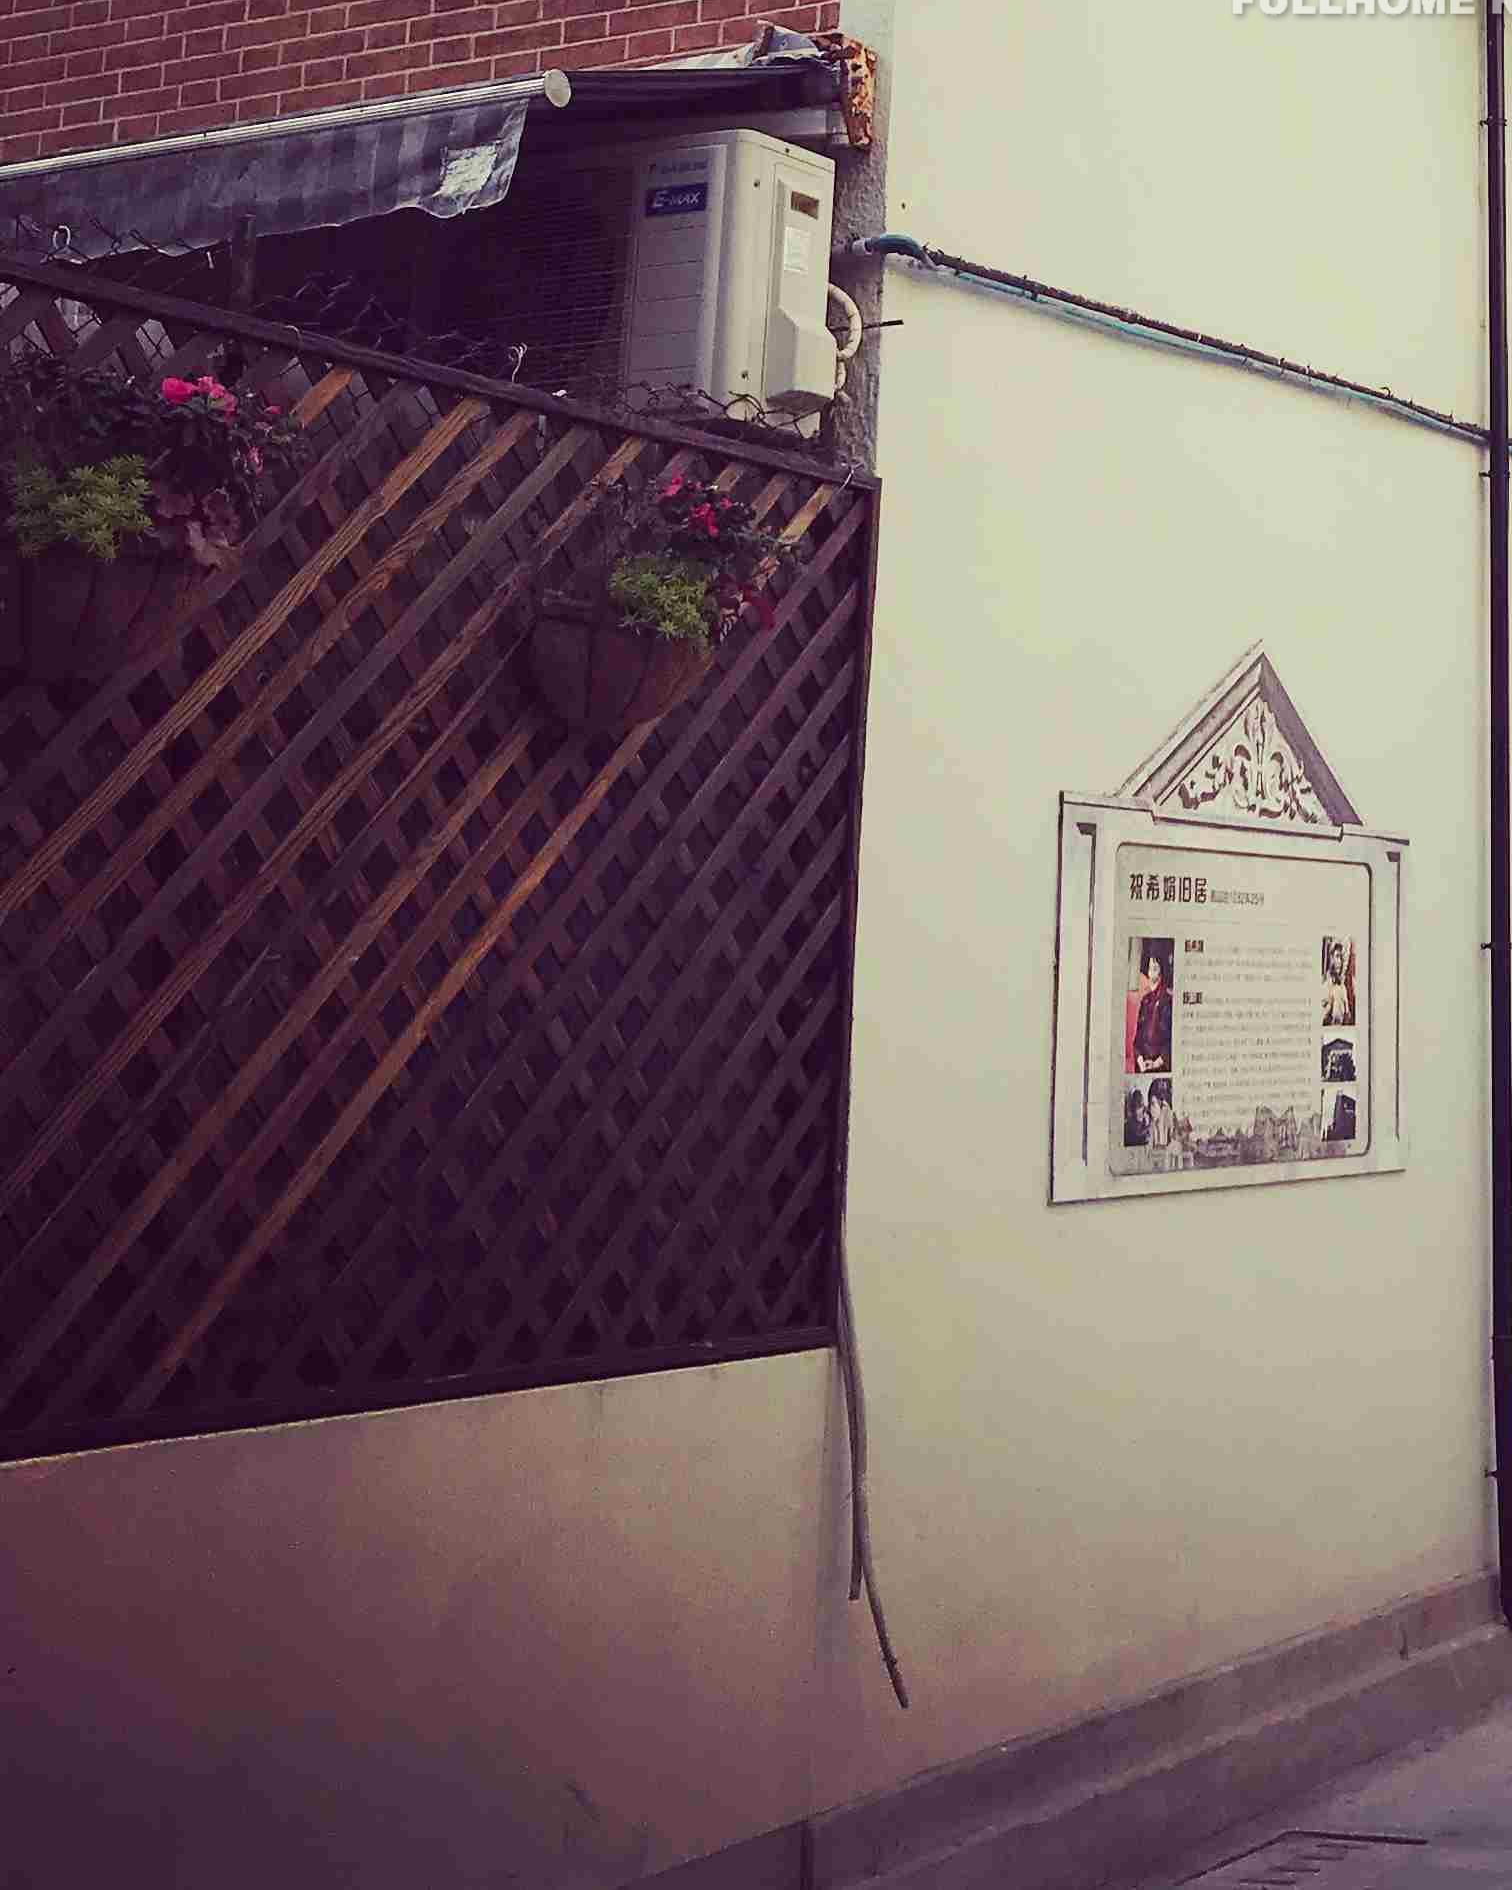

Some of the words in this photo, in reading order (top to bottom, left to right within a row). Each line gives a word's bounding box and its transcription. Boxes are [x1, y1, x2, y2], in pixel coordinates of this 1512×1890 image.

[1129, 873, 1208, 904] 祝希娟旧居
